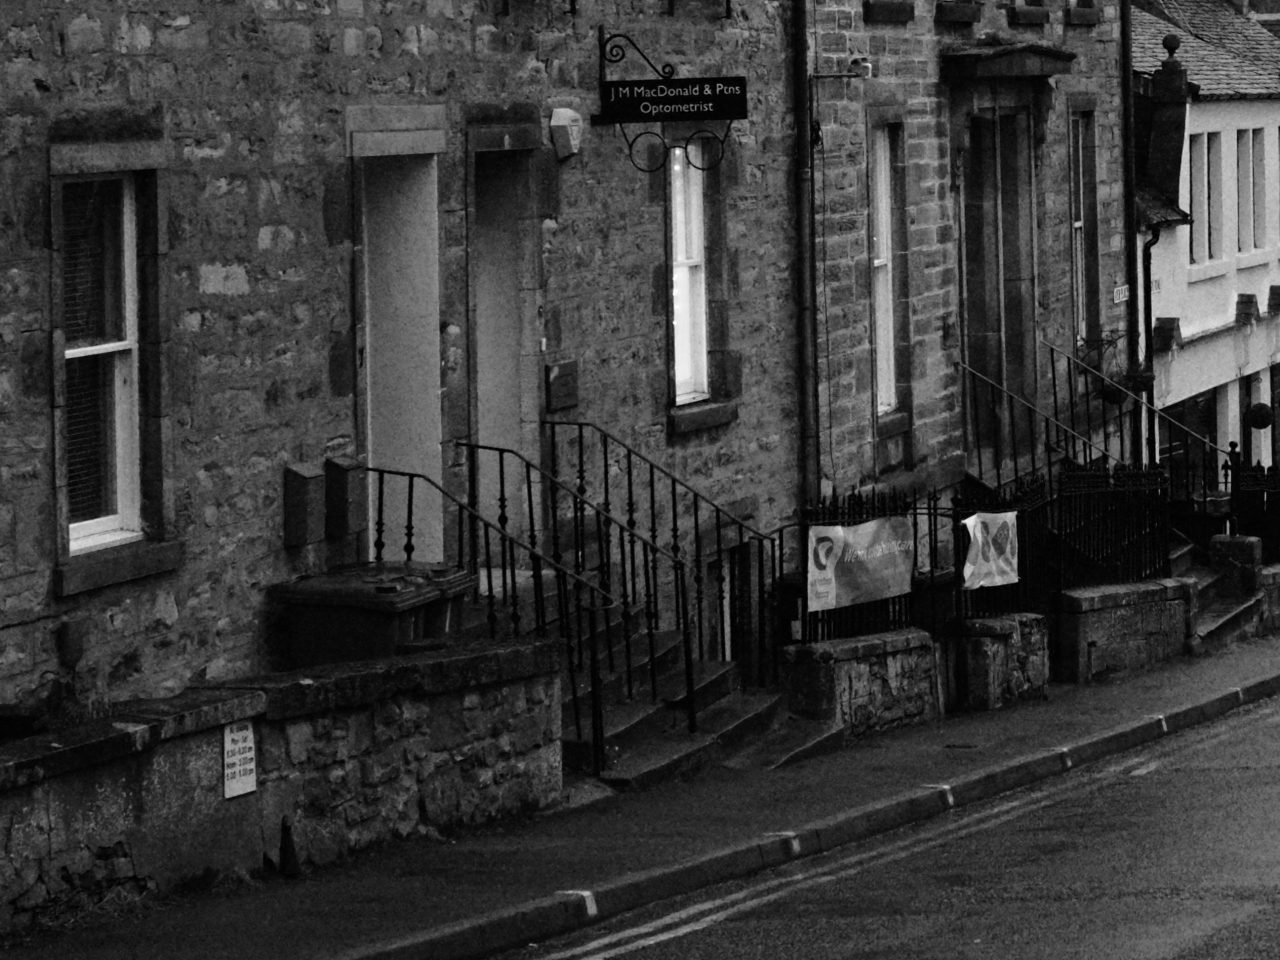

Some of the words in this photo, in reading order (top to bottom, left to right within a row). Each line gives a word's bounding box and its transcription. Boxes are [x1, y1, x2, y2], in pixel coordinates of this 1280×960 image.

[610, 88, 615, 102] J
[619, 87, 630, 98] M
[634, 85, 700, 98] MacDonald
[703, 85, 712, 96] &
[716, 83, 741, 96] Ptns
[640, 100, 714, 116] Optometrist
